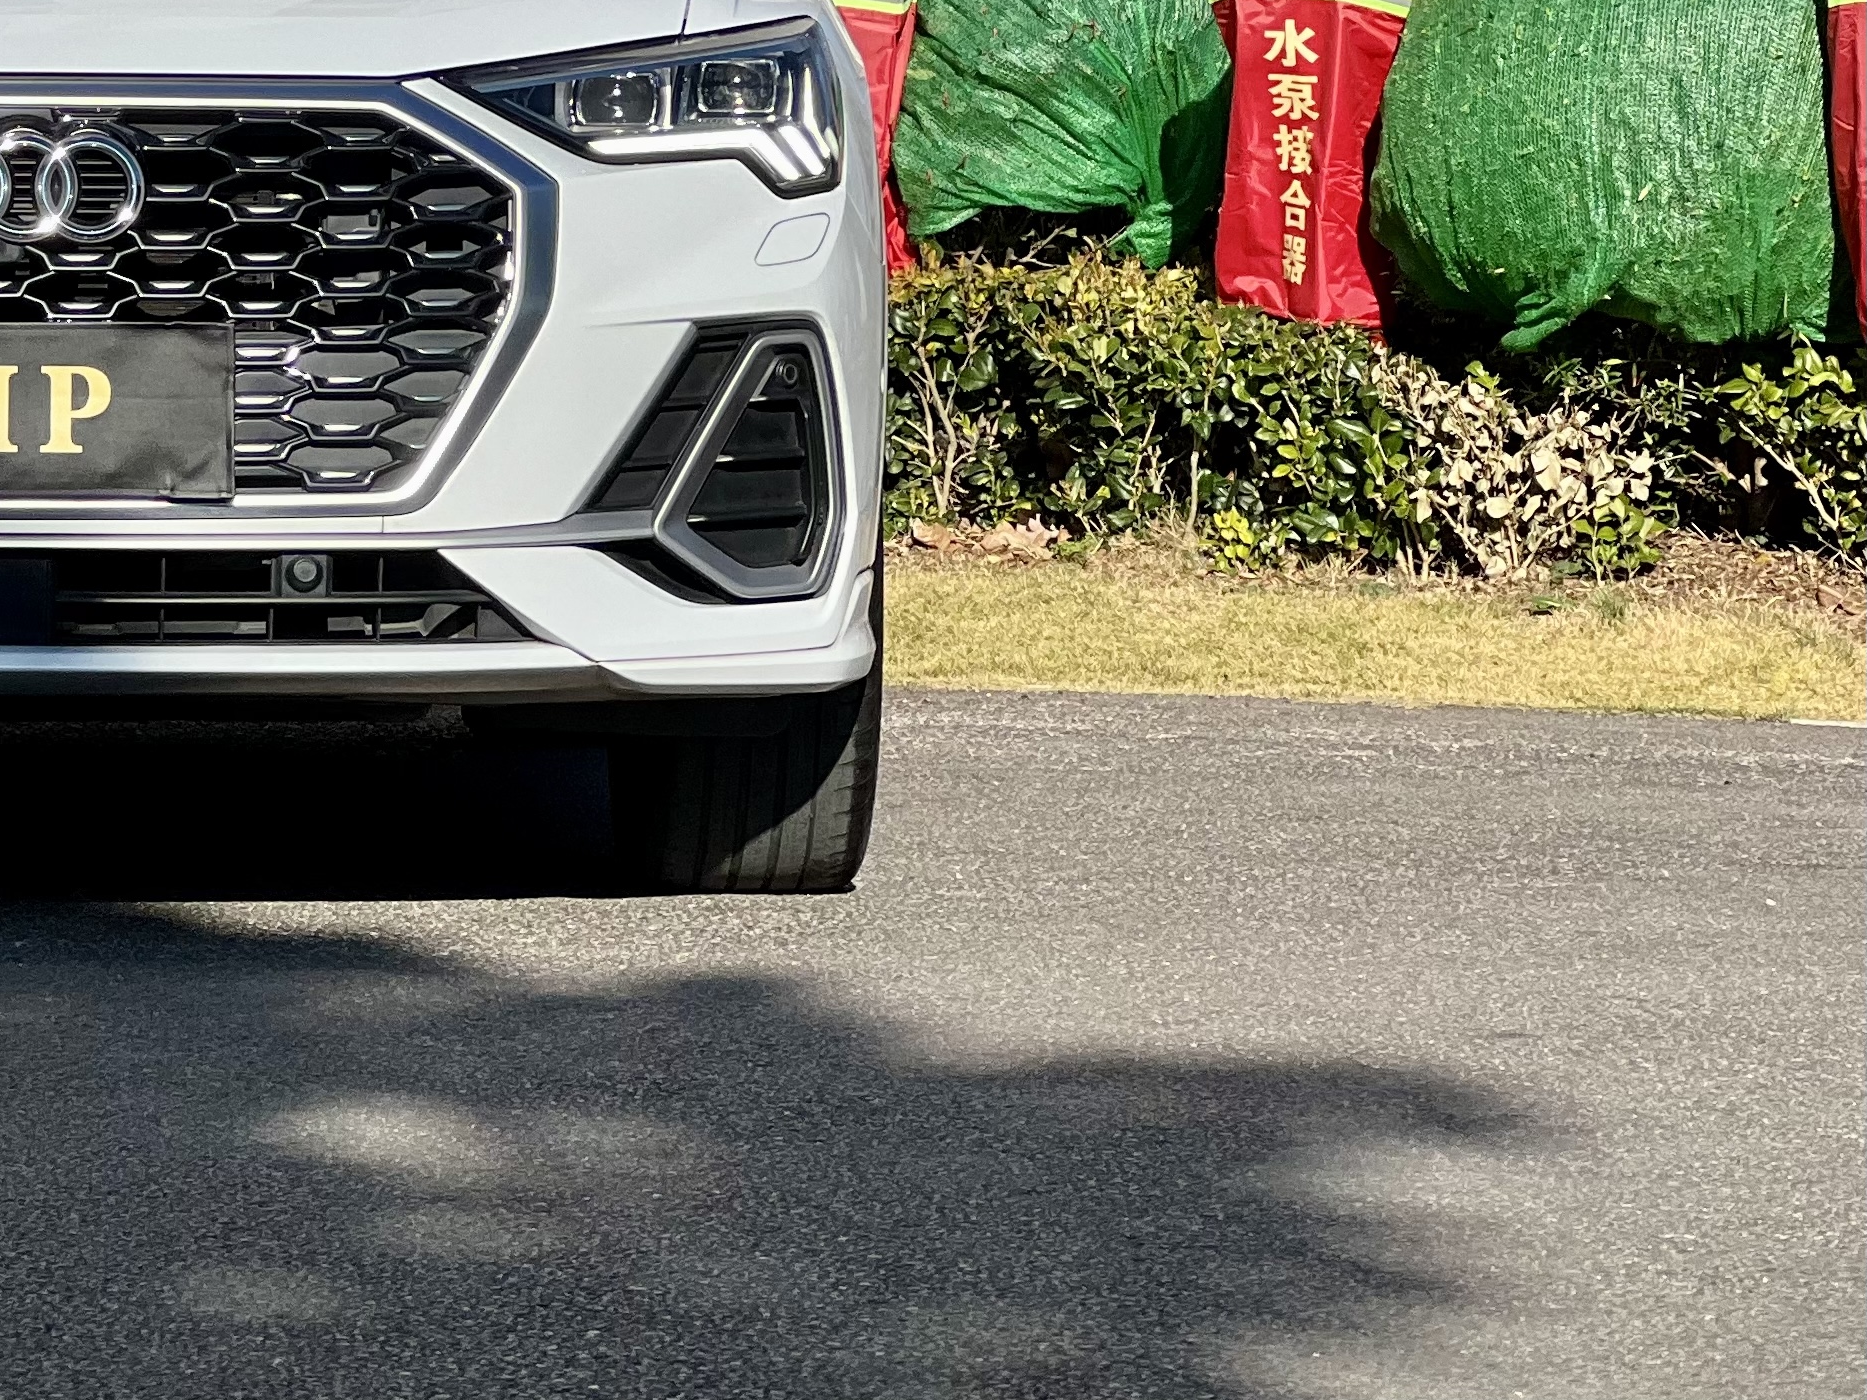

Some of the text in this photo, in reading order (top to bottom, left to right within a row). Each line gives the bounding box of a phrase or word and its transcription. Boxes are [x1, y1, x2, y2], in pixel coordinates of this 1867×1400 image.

[1263, 19, 1320, 286] 水泵接合器
